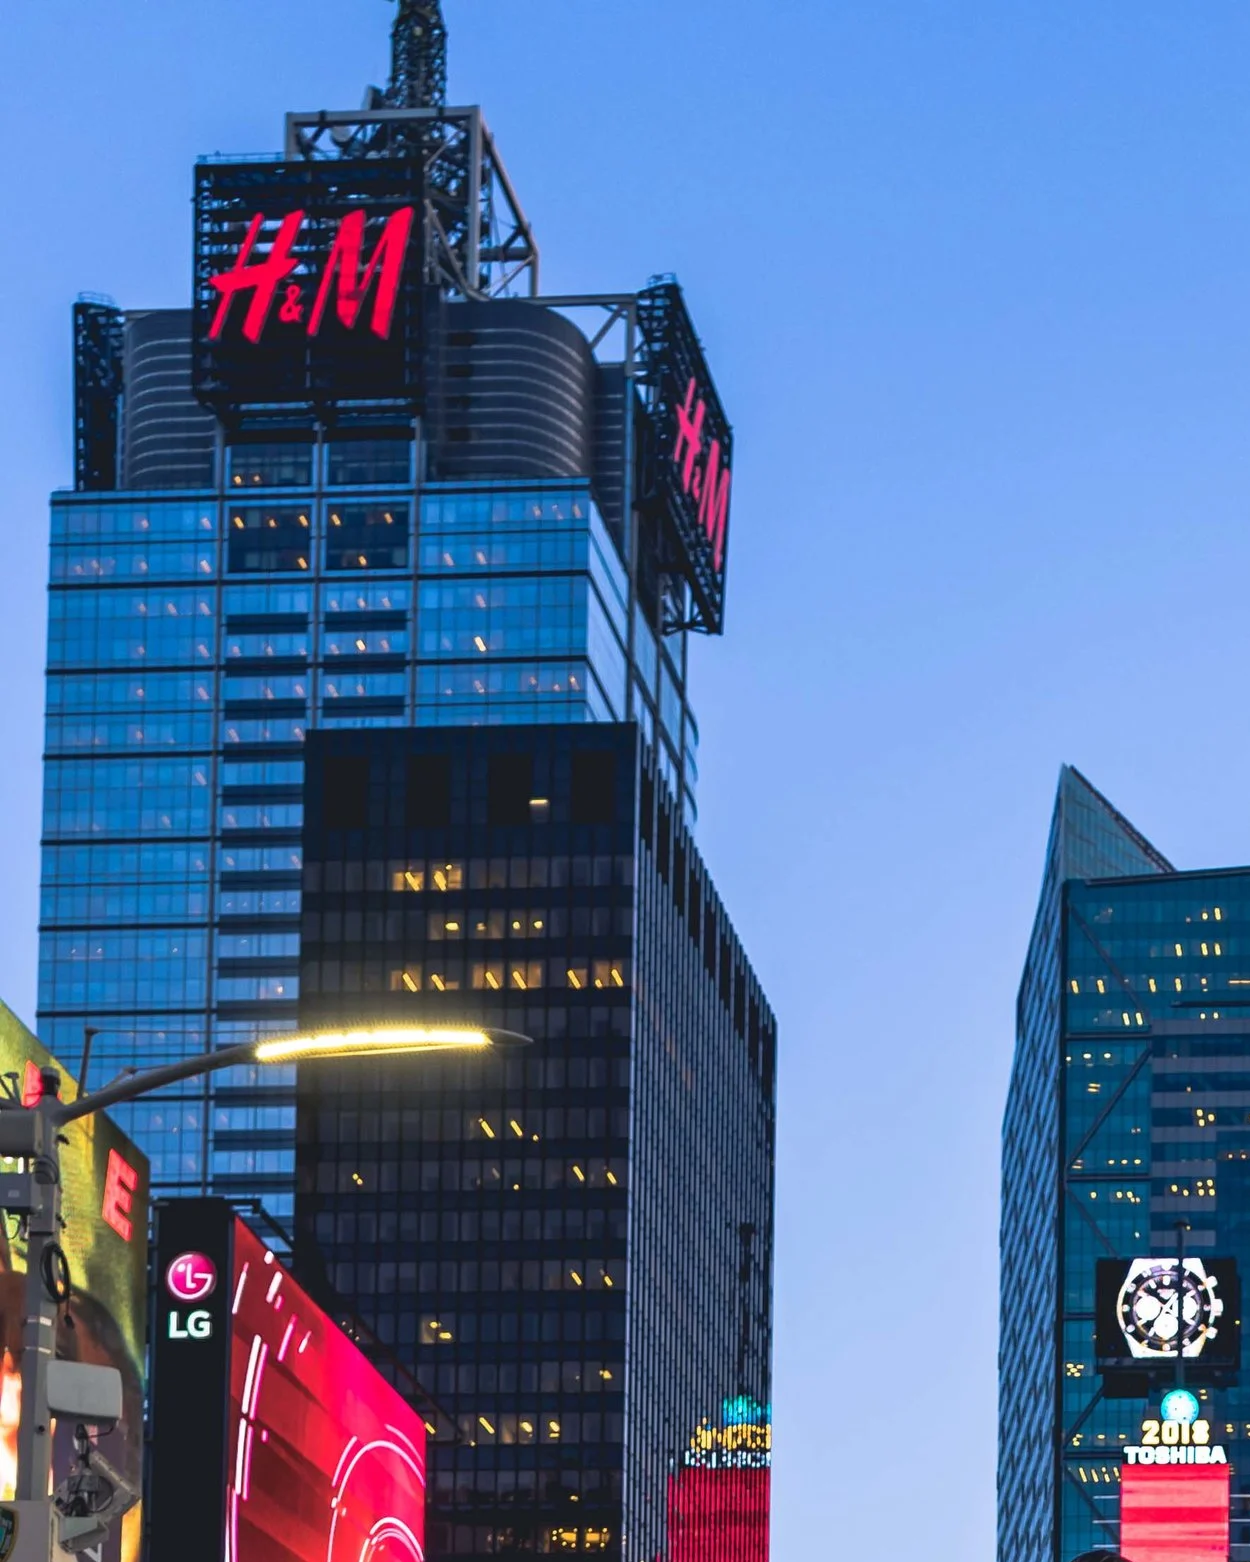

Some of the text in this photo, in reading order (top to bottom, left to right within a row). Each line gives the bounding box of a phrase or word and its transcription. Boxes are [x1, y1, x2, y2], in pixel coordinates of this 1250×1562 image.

[209, 206, 414, 345] H&M
[674, 377, 731, 571] H&M
[167, 1310, 213, 1339] LG
[1141, 1419, 1211, 1446] 2018
[1123, 1445, 1228, 1465] TOSHIBA
